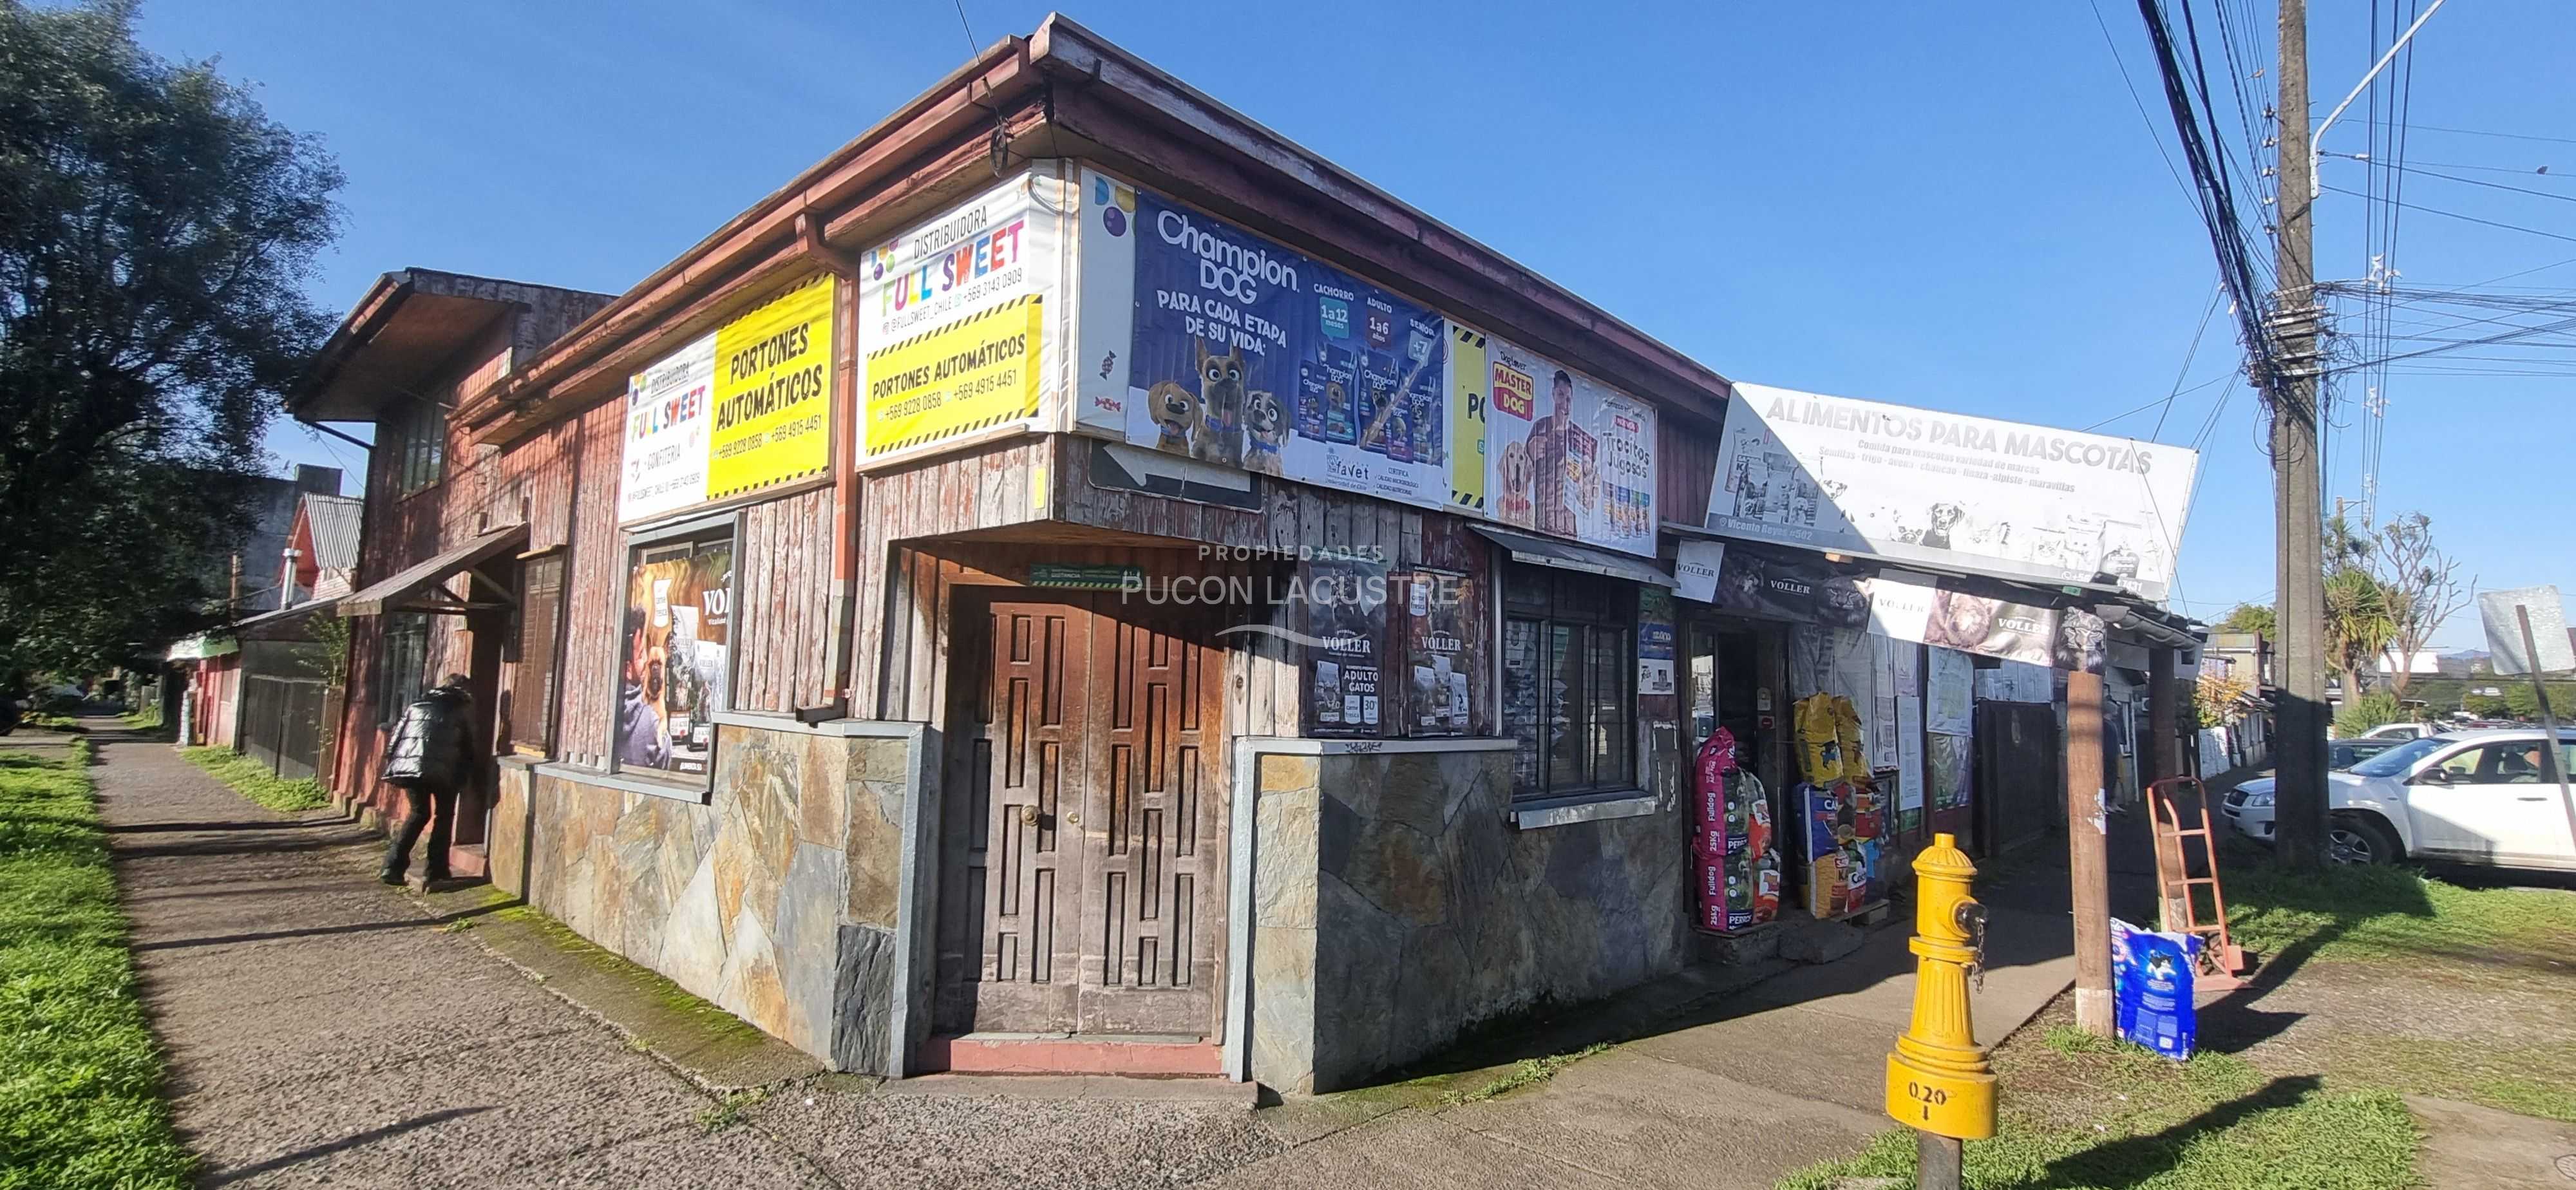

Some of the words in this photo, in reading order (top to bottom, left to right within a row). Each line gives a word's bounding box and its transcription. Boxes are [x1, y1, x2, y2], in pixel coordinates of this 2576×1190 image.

[914, 205, 987, 259] DISTRIBUIDORA
[1158, 210, 1297, 290] Champion
[882, 265, 933, 317] FULL
[942, 220, 1024, 292] SWEET
[983, 277, 1000, 296] 3143
[1002, 268, 1023, 288] 0909
[1200, 258, 1257, 305] DOG
[1313, 283, 1354, 301] CACHORRO
[1367, 297, 1392, 314] ADULTO
[1157, 290, 1200, 314] PARA
[1204, 299, 1241, 327] CADA
[1245, 313, 1286, 348] ETAPA
[1186, 316, 1205, 337] DE
[1208, 322, 1226, 343] SU
[730, 322, 809, 385] PORTONES
[873, 365, 931, 401] PORTONES
[934, 333, 1025, 382] AUTOMÁTICOS
[885, 403, 902, 420] +569
[904, 397, 921, 416] 9228
[923, 392, 942, 411] 0858
[953, 382, 973, 401] +569
[975, 375, 994, 395] 4915
[997, 368, 1017, 388] 4451
[1495, 368, 1531, 395] MASTER
[716, 364, 822, 431] AUTOMÁTICOS
[1503, 393, 1525, 415] DOG
[630, 407, 659, 443] FULL
[663, 385, 706, 430] SWEET
[772, 425, 786, 442] +569
[788, 419, 803, 438] 4915
[805, 414, 821, 433] 4451
[1602, 432, 1649, 466] Trocitos
[1766, 396, 1923, 442] ALIMENTOS
[1929, 420, 1996, 453] PARA
[2003, 431, 2153, 475] MASCOTAS
[1607, 451, 1647, 478] Jugosos
[1819, 446, 1855, 460] Semillas
[1861, 451, 1882, 465] trigo
[2029, 478, 2075, 493] maravillas
[1858, 439, 1890, 453] Comida
[1891, 444, 1911, 456] para
[1913, 448, 1954, 463] mascotas
[1955, 453, 1994, 470] variedad
[1994, 460, 2006, 470] de
[2007, 463, 2040, 475] marcas
[1727, 518, 1760, 533] Vicente
[1790, 528, 1813, 540] #502
[1678, 563, 1714, 578] VOLLER
[1771, 580, 1810, 594] VOLLER
[1879, 599, 1926, 612] VOLER
[1998, 618, 2050, 635] VOLLER
[1322, 636, 1371, 654] VOLLER
[1422, 636, 1461, 652] VOLLER
[1344, 670, 1378, 682] ADULTO
[1349, 683, 1375, 692] GATOS
[1707, 792, 1716, 822] Fulldog
[1909, 1082, 1946, 1106] 0.20
